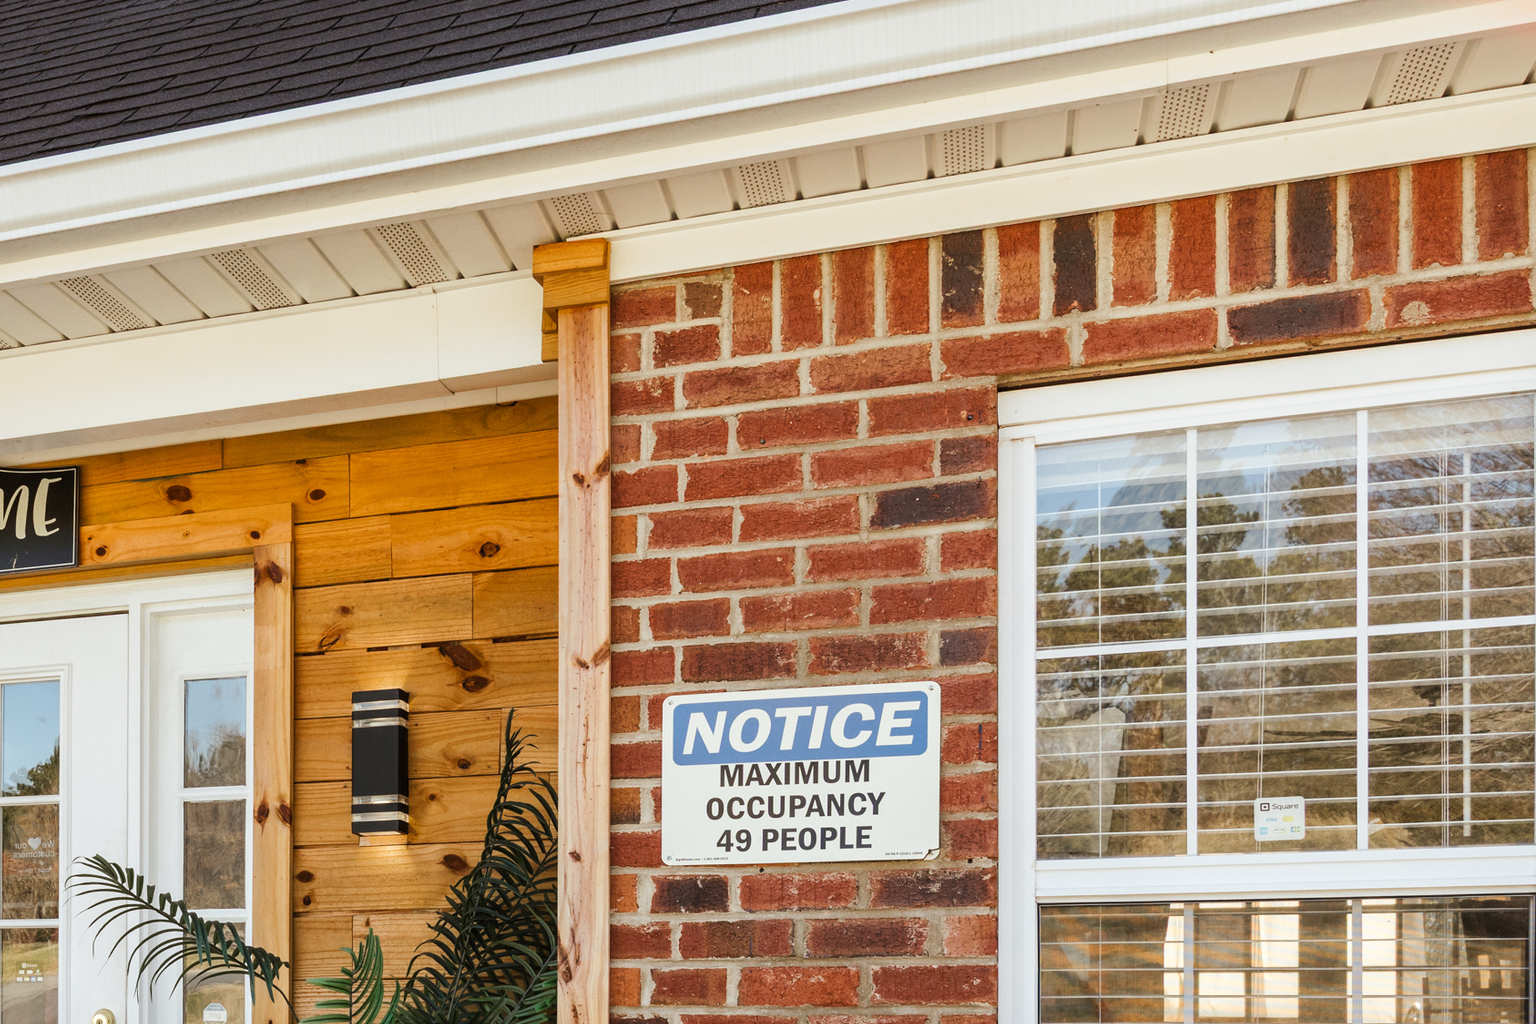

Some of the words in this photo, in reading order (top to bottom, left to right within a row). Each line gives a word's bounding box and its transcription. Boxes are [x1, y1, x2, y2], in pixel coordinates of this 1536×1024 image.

[682, 700, 921, 755] NOTICE
[719, 759, 870, 787] MAXIMUM
[706, 792, 886, 820] OCCUPANCY
[1271, 803, 1300, 811] Square
[716, 829, 752, 852] 49
[762, 826, 873, 851] PEOPLE
